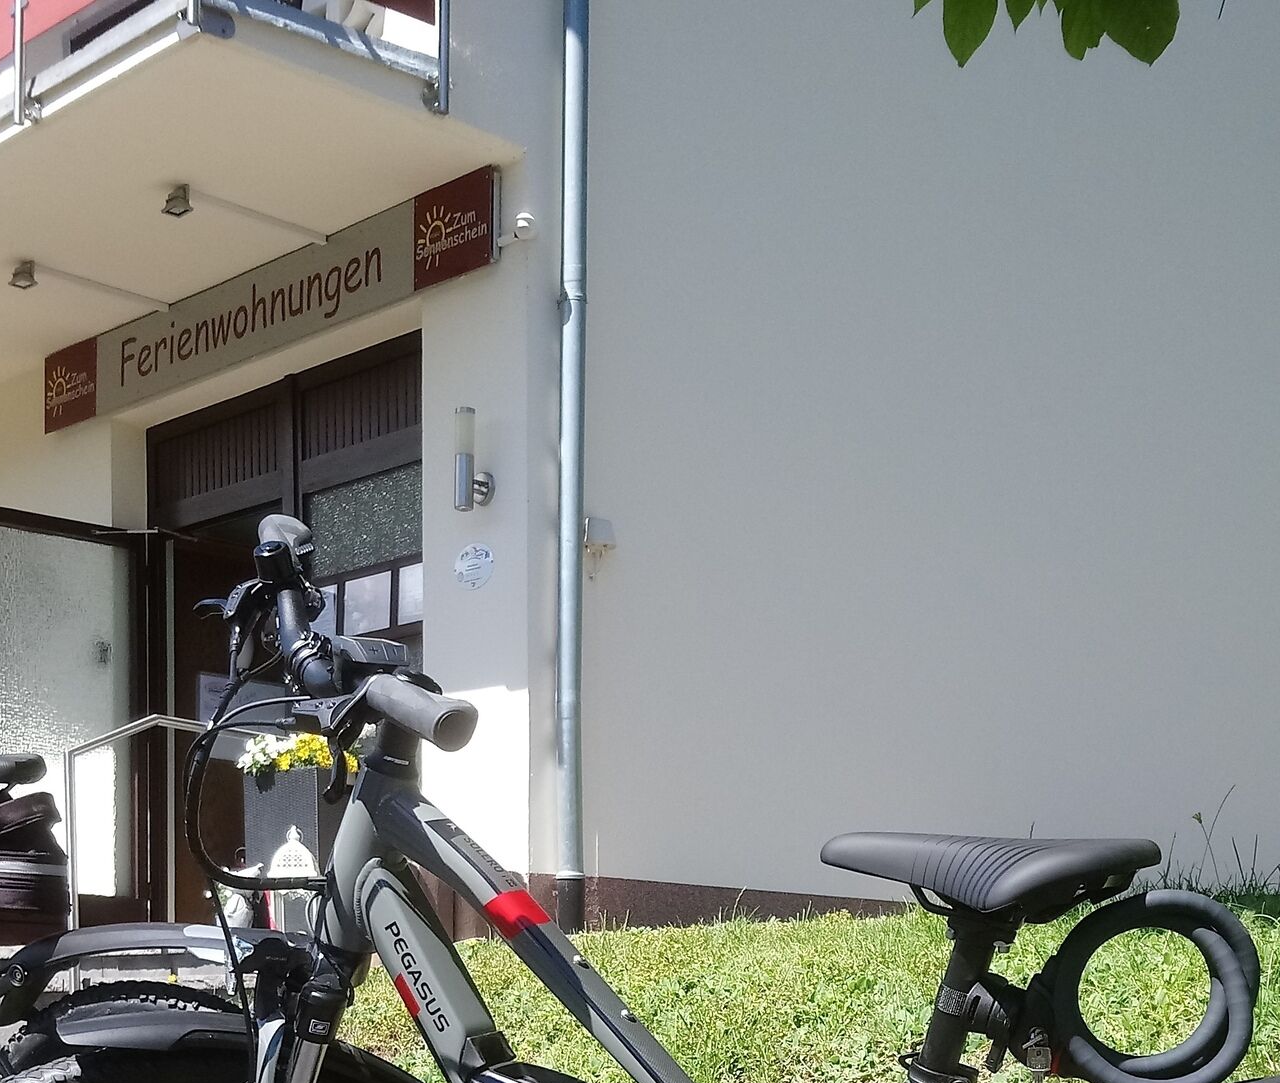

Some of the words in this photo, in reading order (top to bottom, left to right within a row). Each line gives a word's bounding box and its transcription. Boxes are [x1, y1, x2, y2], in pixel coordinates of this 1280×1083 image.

[452, 210, 477, 230] Zum
[415, 221, 488, 260] Sonnenschein
[121, 246, 383, 388] Ferienwohnungen
[70, 371, 88, 386] Zum
[384, 920, 450, 1033] PEGASUS
